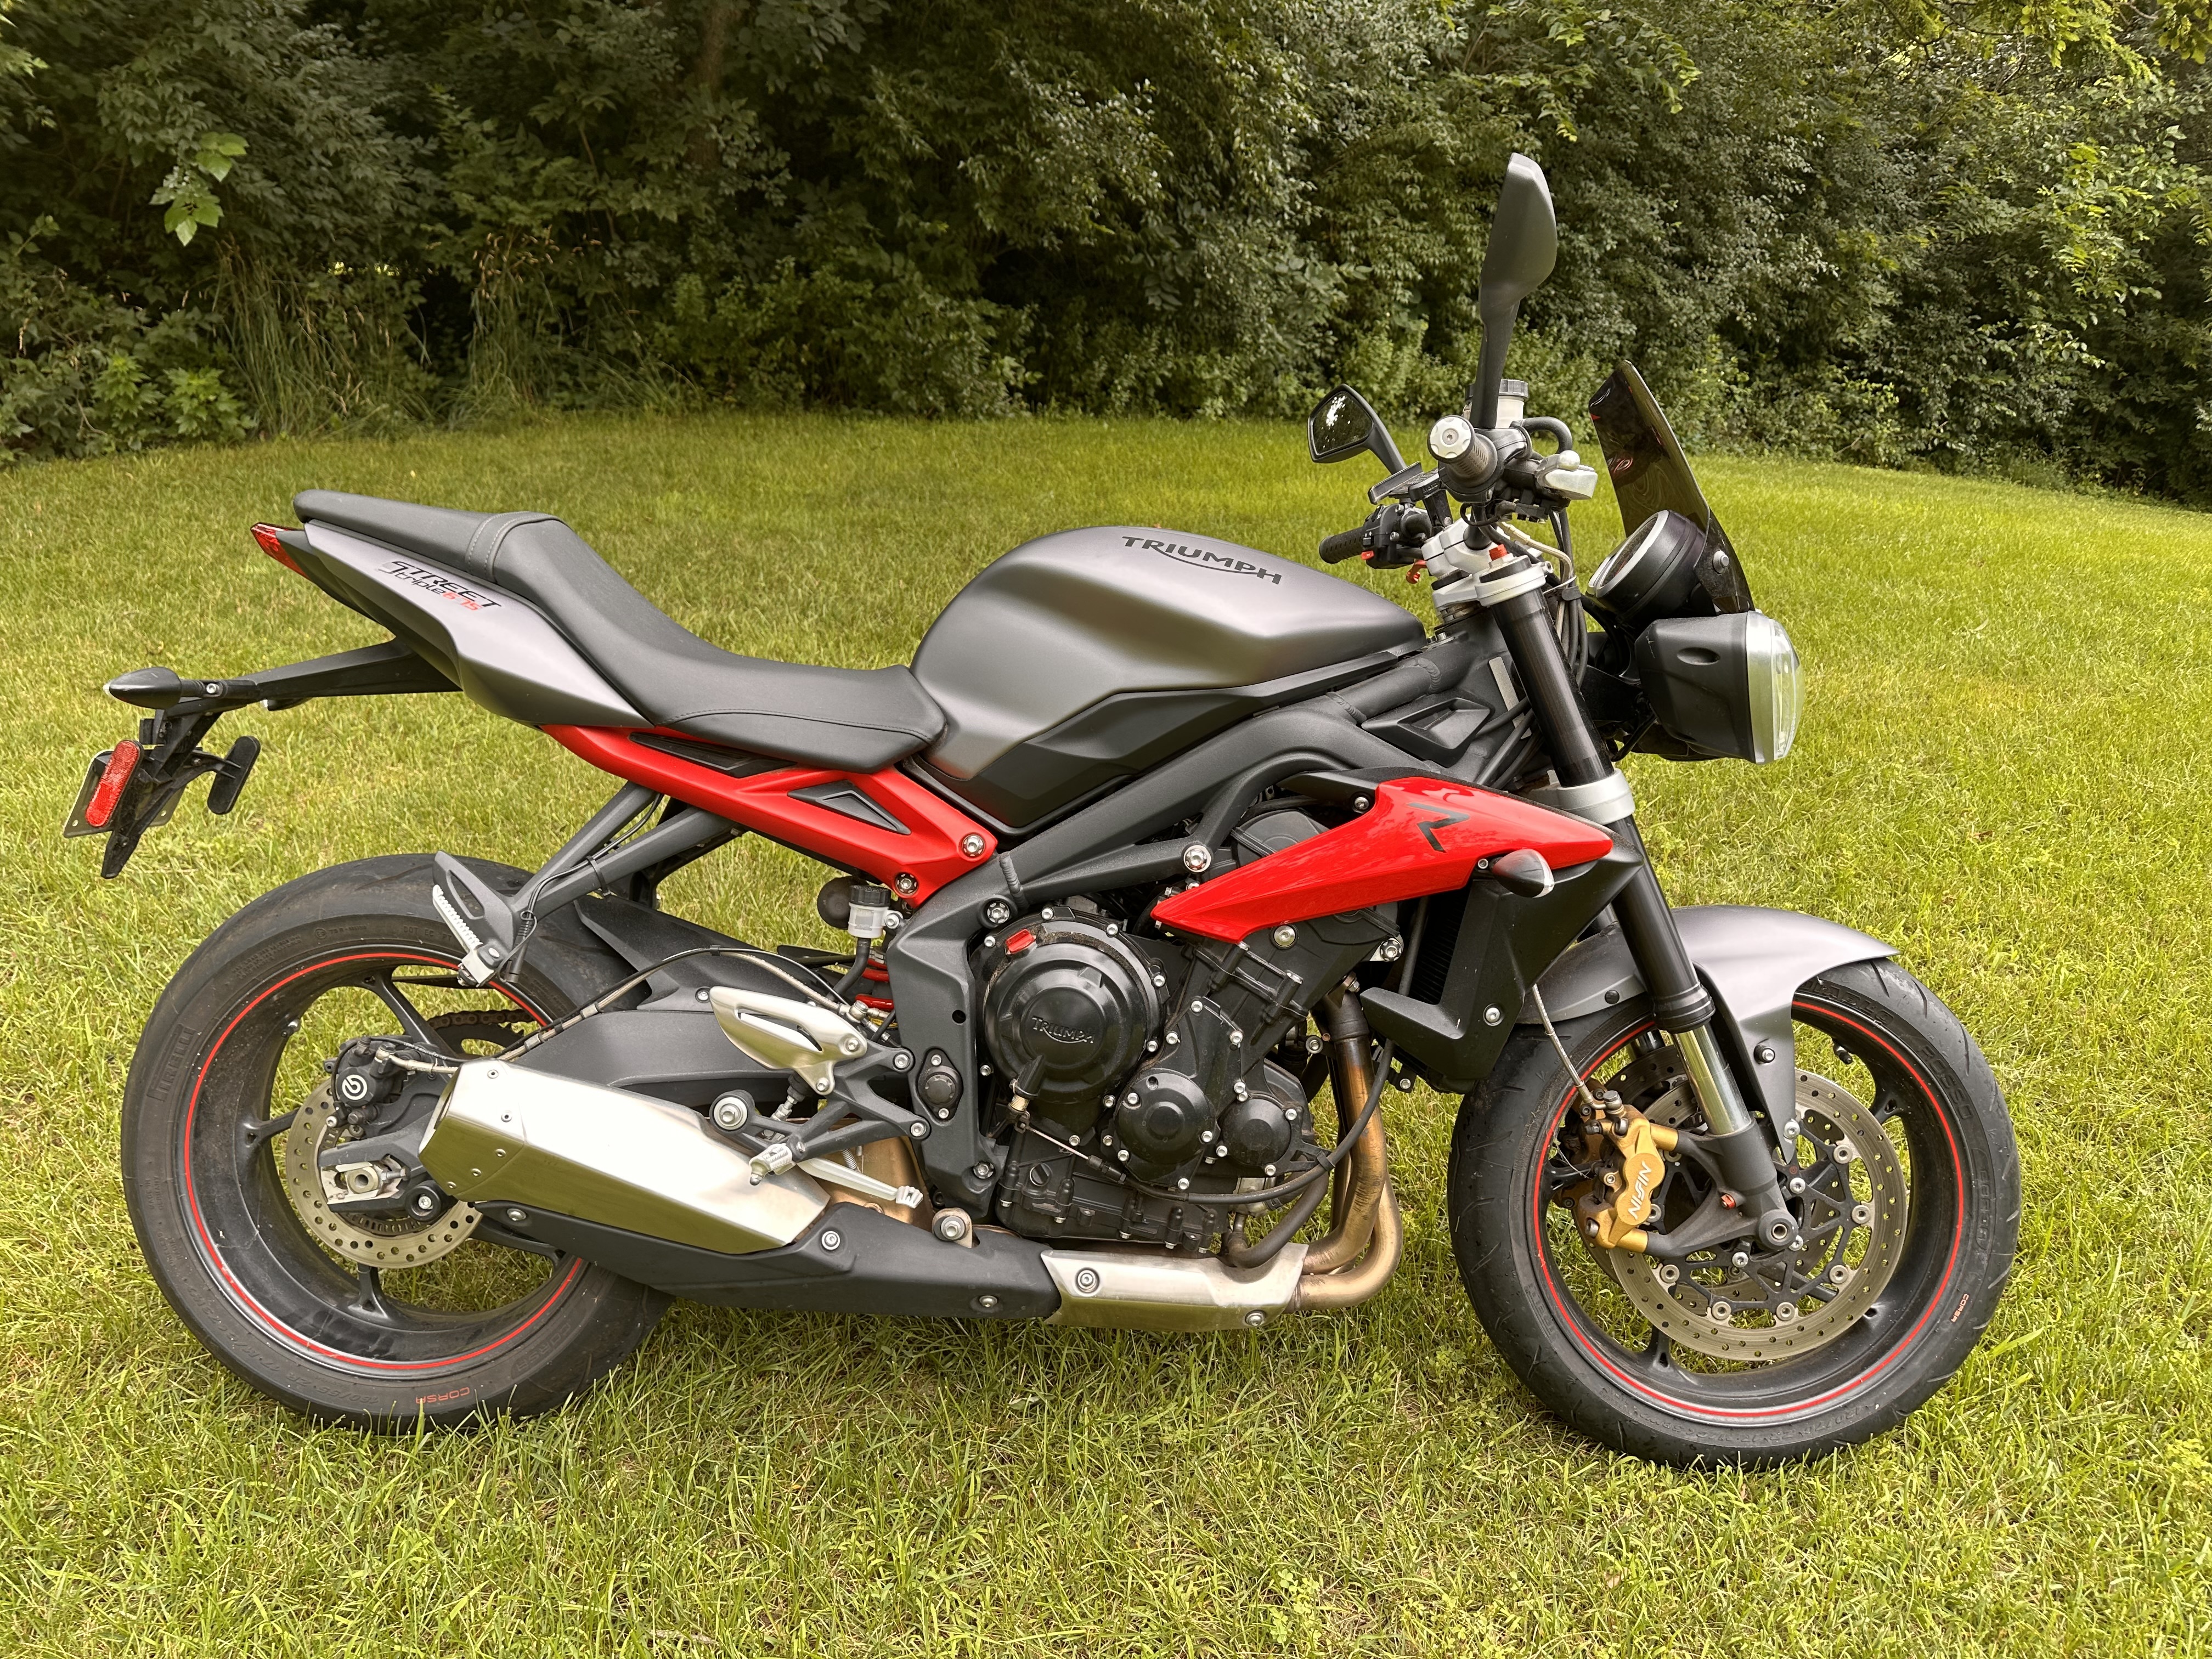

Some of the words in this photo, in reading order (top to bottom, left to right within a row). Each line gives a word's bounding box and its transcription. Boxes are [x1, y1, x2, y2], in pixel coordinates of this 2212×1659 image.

[1122, 536, 1282, 585] TRIUMPH
[377, 561, 501, 607] STREET
[1031, 1015, 1095, 1043] TRIUMPH
[1917, 1043, 1974, 1119] ROSSO
[1950, 1293, 1970, 1322] CORSA
[415, 1387, 470, 1404] CORSA
